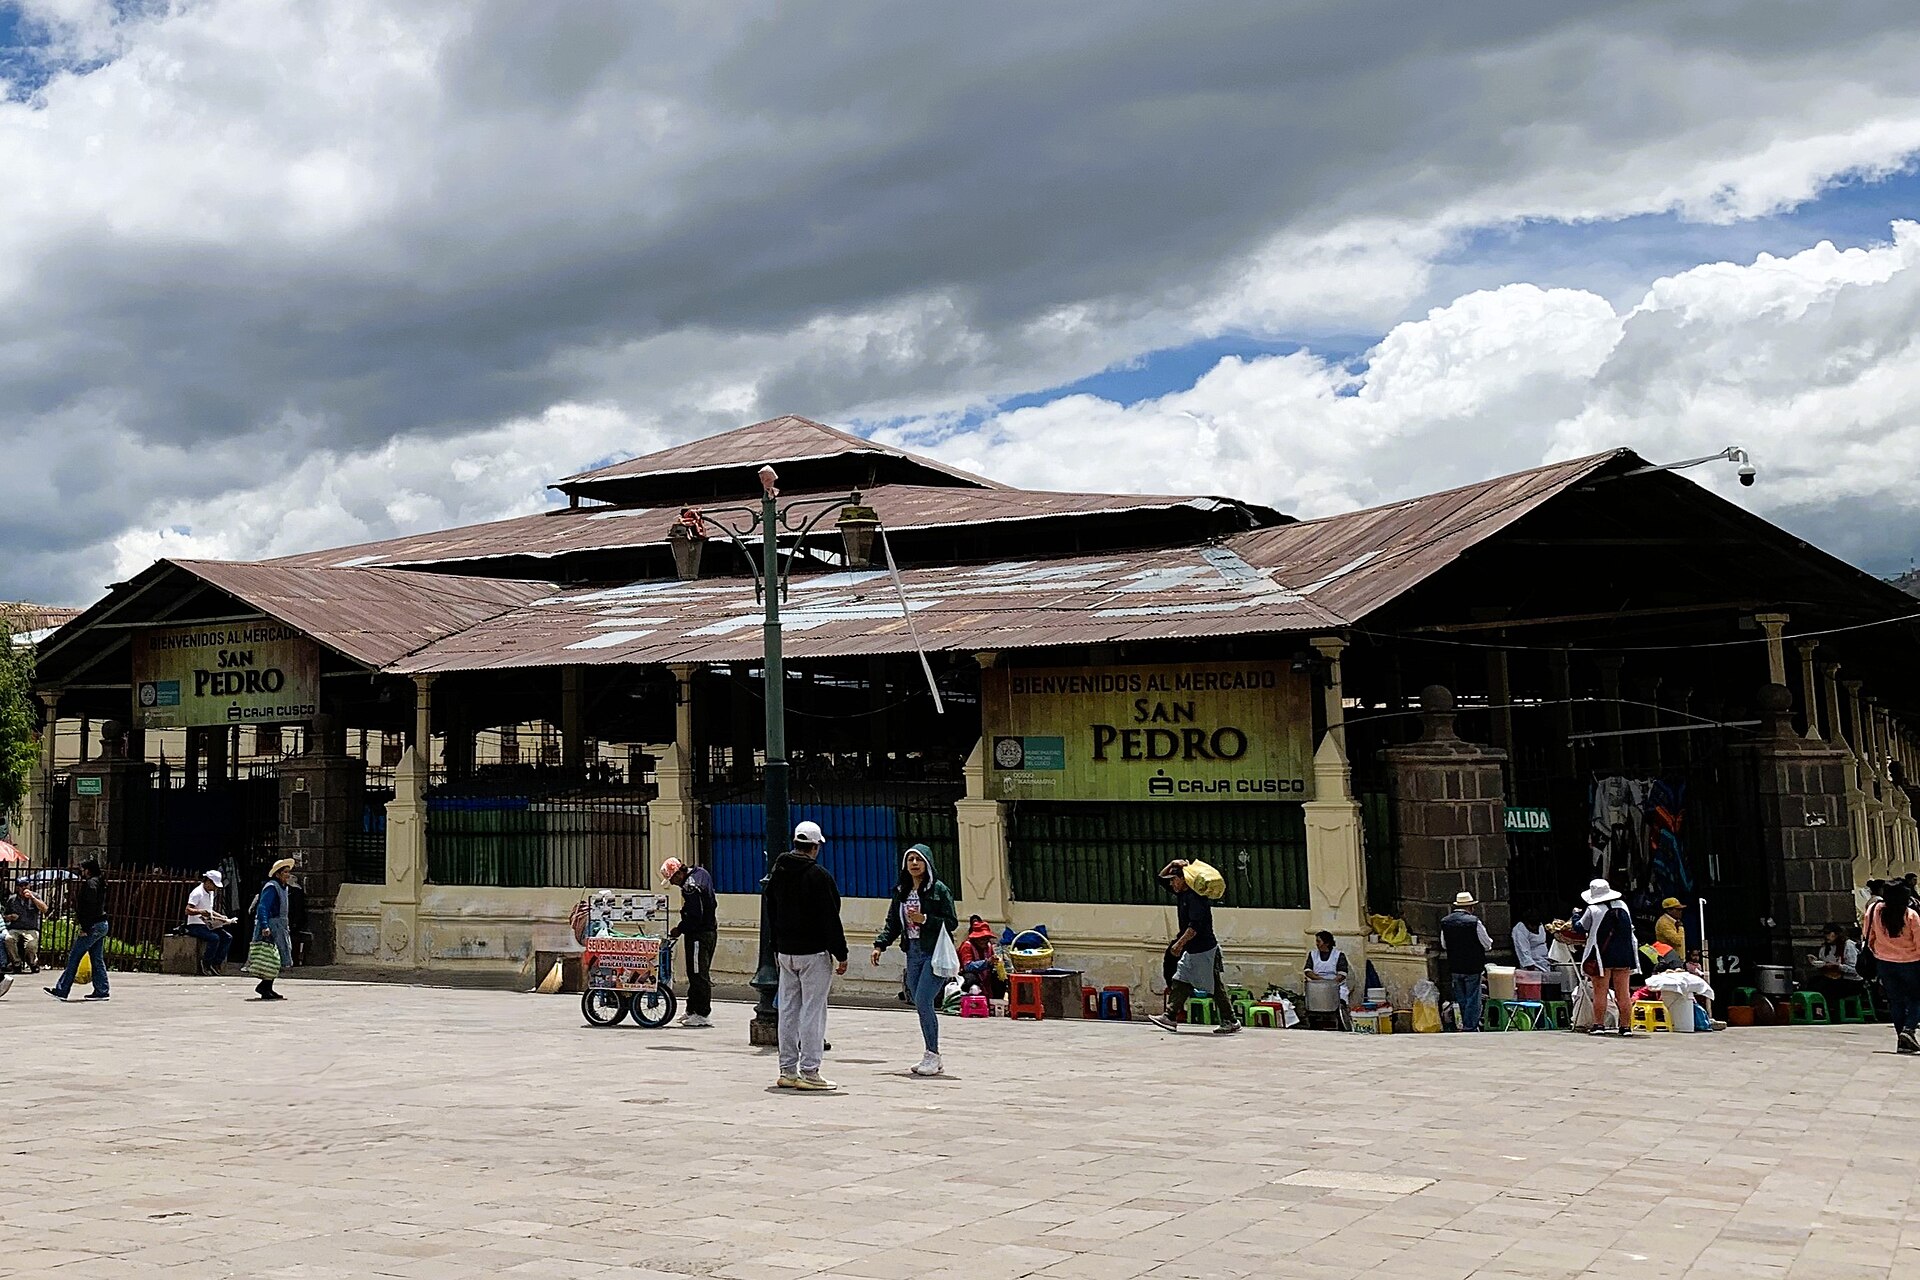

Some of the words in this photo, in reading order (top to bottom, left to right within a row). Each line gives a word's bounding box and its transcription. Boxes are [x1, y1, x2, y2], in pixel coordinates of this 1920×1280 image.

[150, 632, 224, 650] BIENVENIDOS
[227, 631, 241, 644] AL
[218, 650, 253, 668] SAN
[193, 668, 285, 697] PEDRO
[1012, 673, 1142, 694] BIENVENIDOS
[1146, 672, 1170, 692] AL
[1174, 670, 1276, 691] MERCADO
[243, 706, 273, 718] CAJA
[276, 705, 315, 716] CUSCO
[1134, 699, 1195, 724] SAN
[1090, 723, 1248, 762] PEDRO
[1177, 779, 1231, 793] CAJA
[1236, 779, 1305, 793] CUSCO
[1716, 955, 1741, 974] 12
